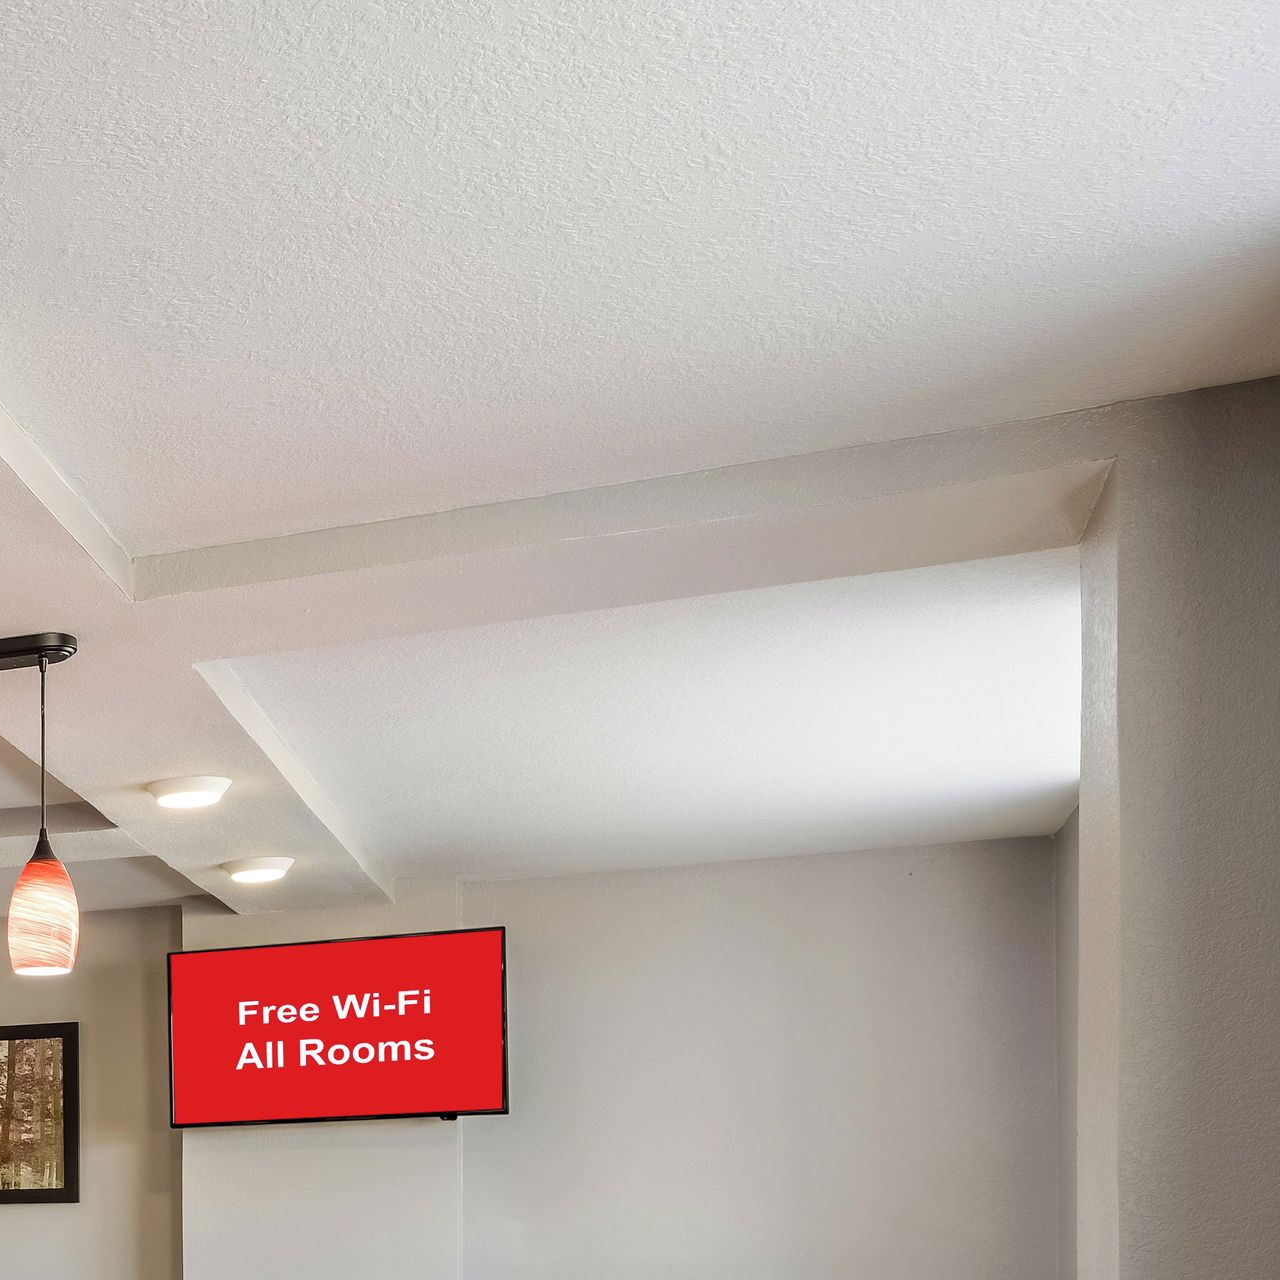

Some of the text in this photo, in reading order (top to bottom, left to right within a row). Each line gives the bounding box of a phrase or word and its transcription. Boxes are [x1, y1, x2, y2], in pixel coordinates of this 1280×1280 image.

[238, 989, 431, 1026] Free Wi-Fi
[235, 1038, 435, 1071] All Rooms
